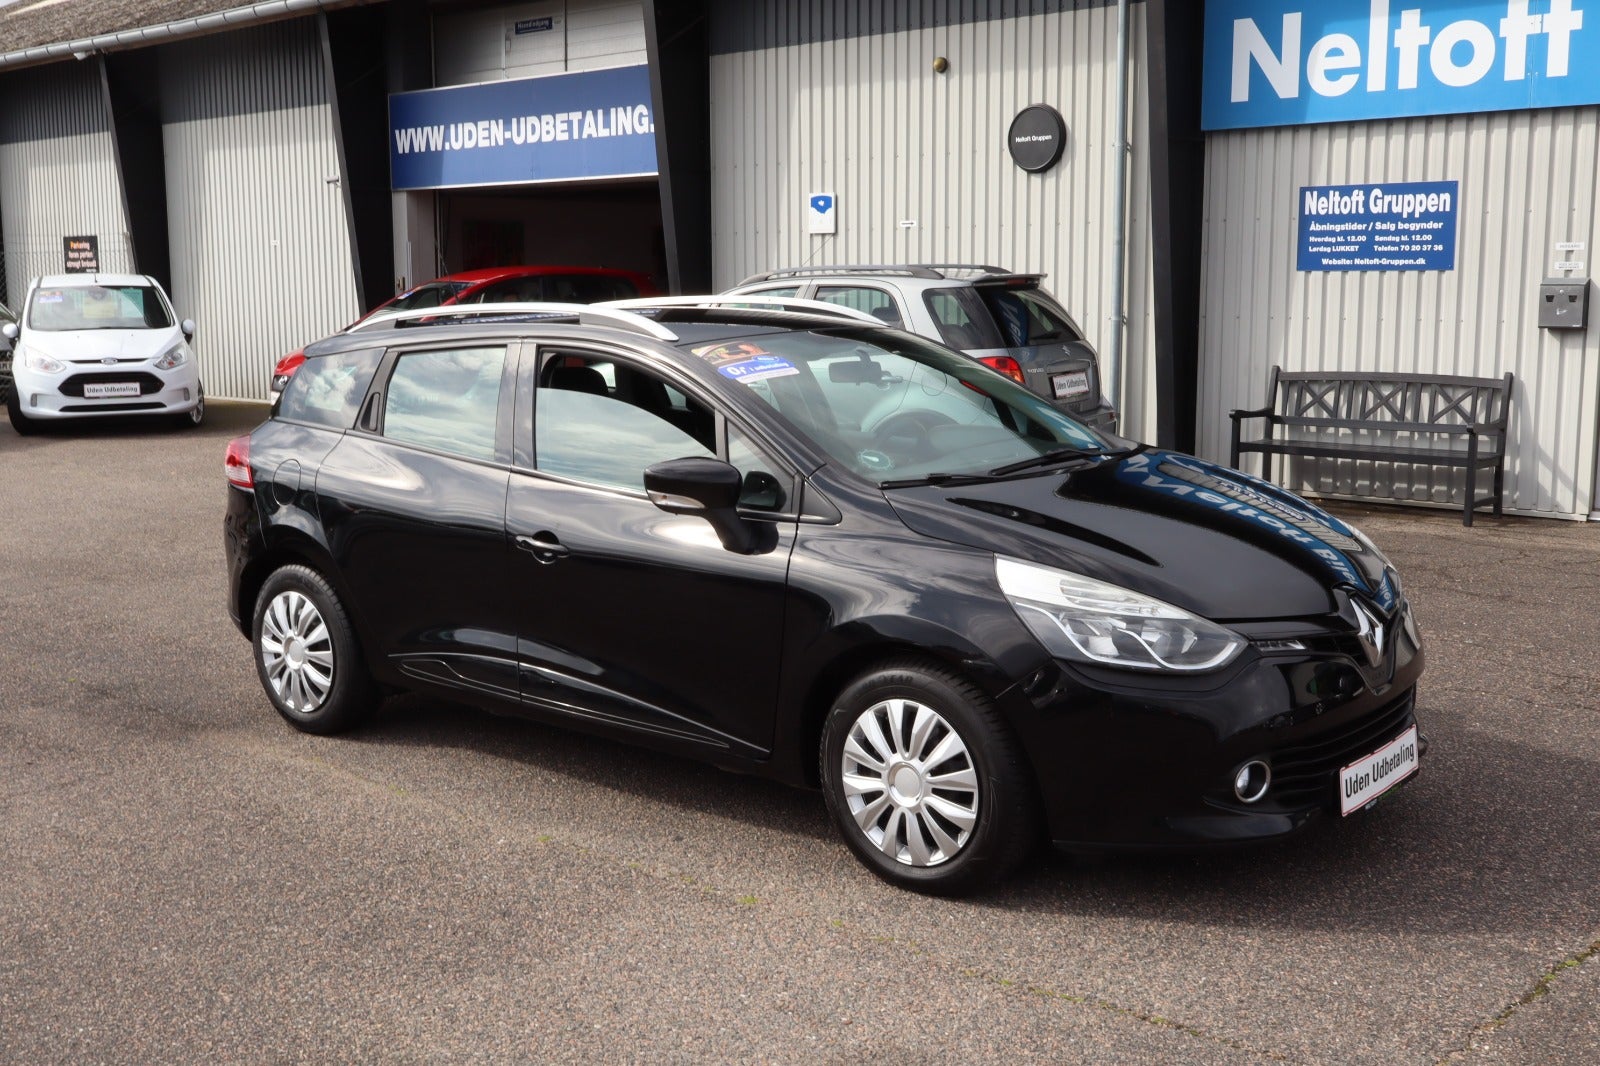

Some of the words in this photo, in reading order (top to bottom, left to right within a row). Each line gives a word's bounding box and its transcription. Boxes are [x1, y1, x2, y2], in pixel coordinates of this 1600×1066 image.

[1231, 0, 1583, 103] Neltoft
[1304, 189, 1365, 215] Neltoft
[1369, 188, 1450, 218] Gruppen
[1309, 221, 1367, 232] Åbningstider
[1368, 222, 1374, 231] /
[1375, 222, 1396, 232] Salg
[1398, 222, 1444, 231] begynder
[1067, 378, 1087, 388] Udbetaling
[1345, 772, 1370, 798] Uden
[1372, 744, 1414, 782] Udbetaling
